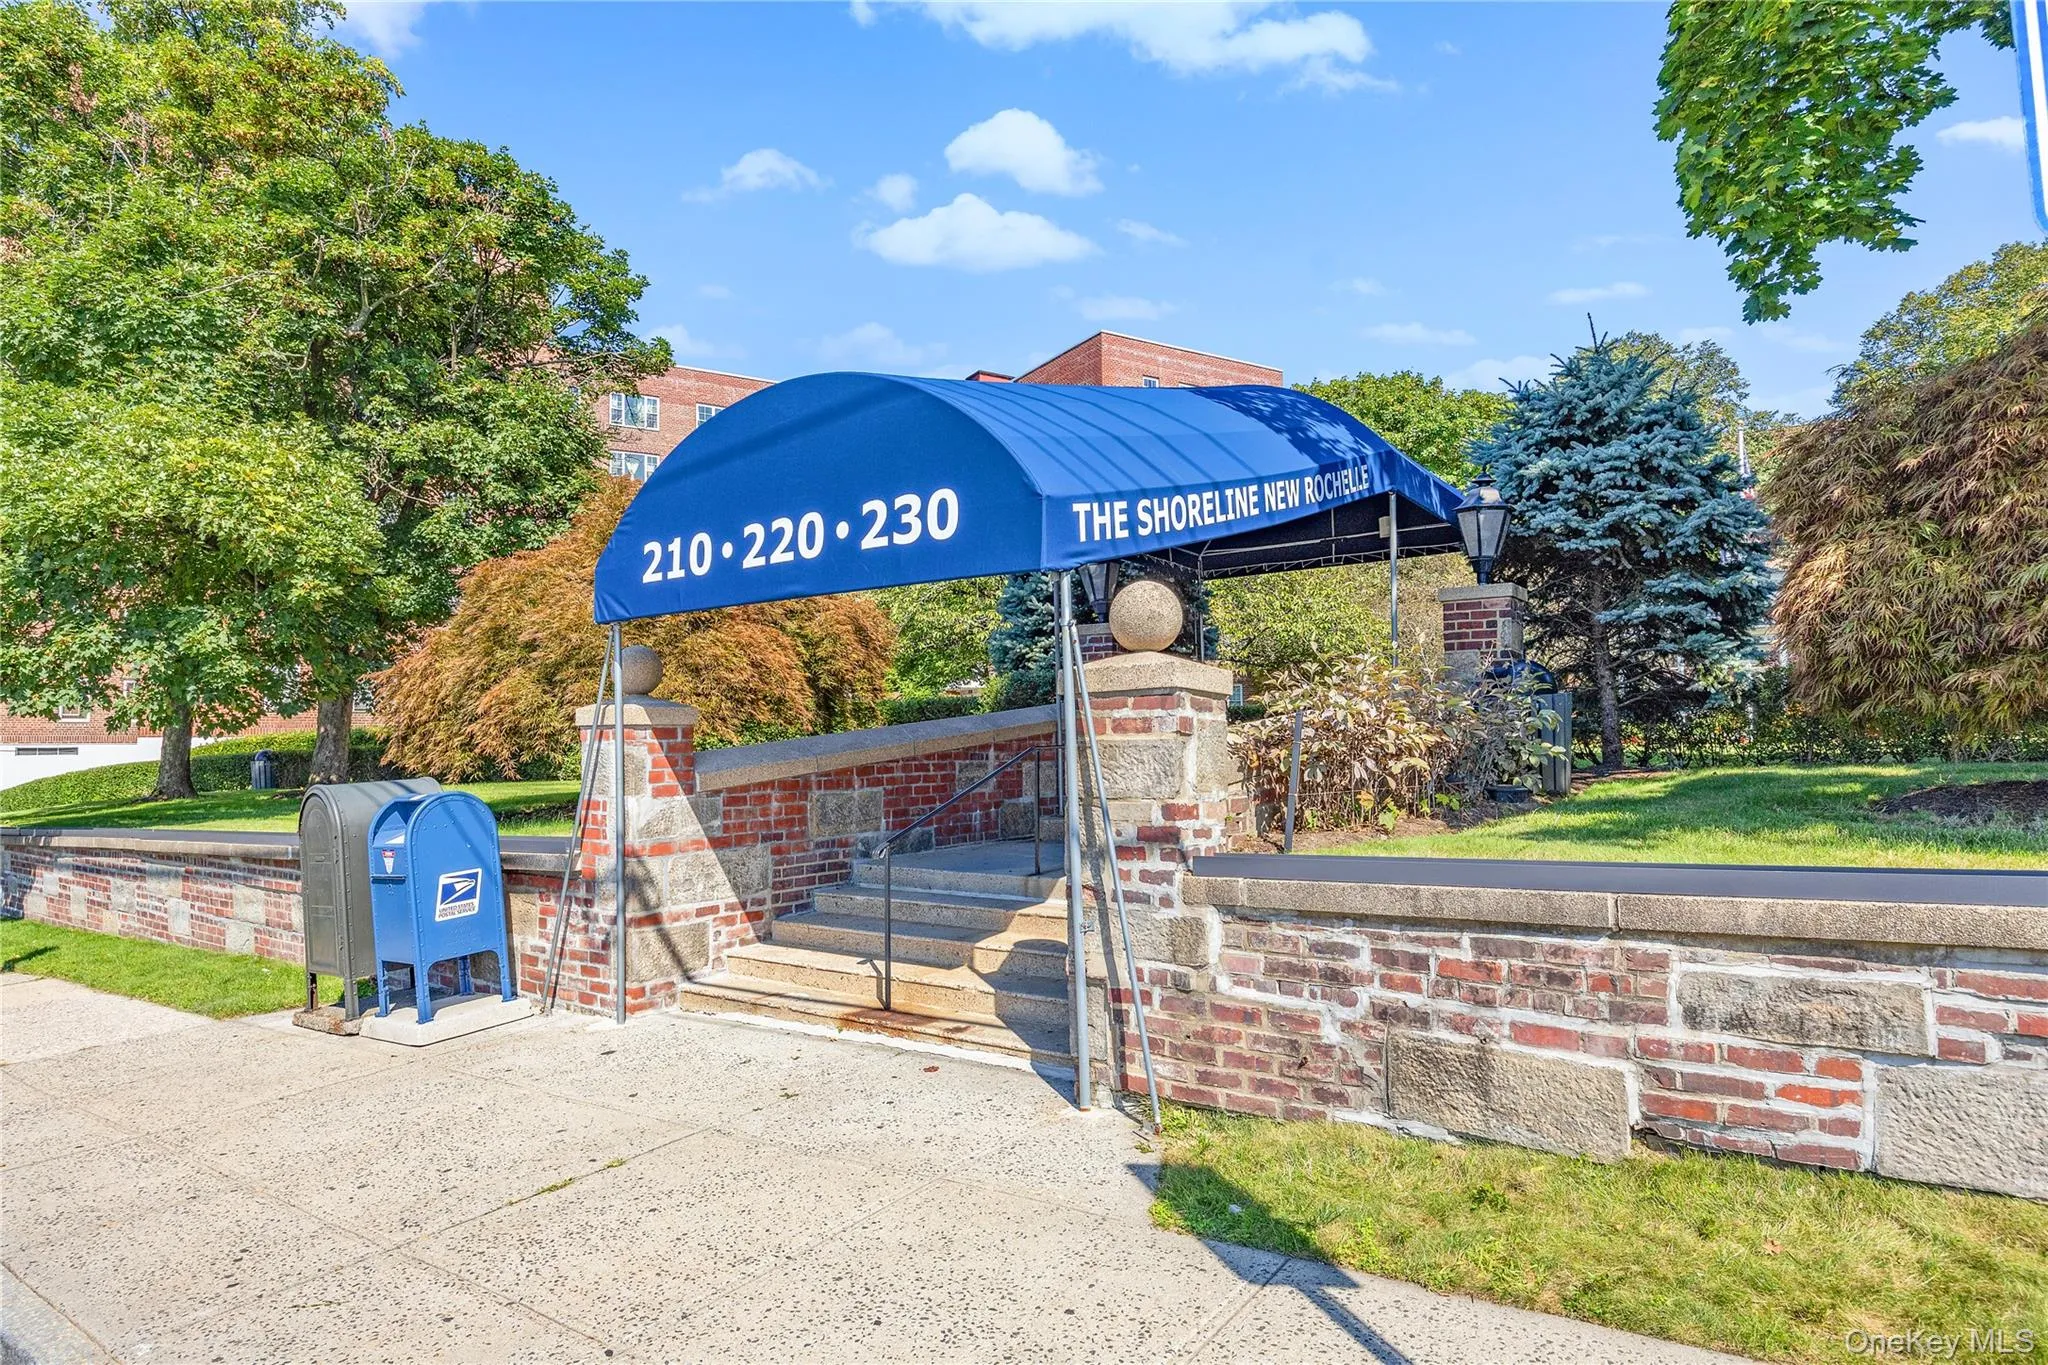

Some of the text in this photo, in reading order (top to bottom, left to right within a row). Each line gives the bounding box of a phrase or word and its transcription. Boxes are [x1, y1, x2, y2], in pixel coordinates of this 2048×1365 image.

[1073, 464, 1370, 542] THE SHORELINE NEW ROCHELLE
[643, 488, 959, 583] 210 220 230
[438, 906, 476, 919] POSTAL SERVICE
[439, 905, 458, 913] UNITED
